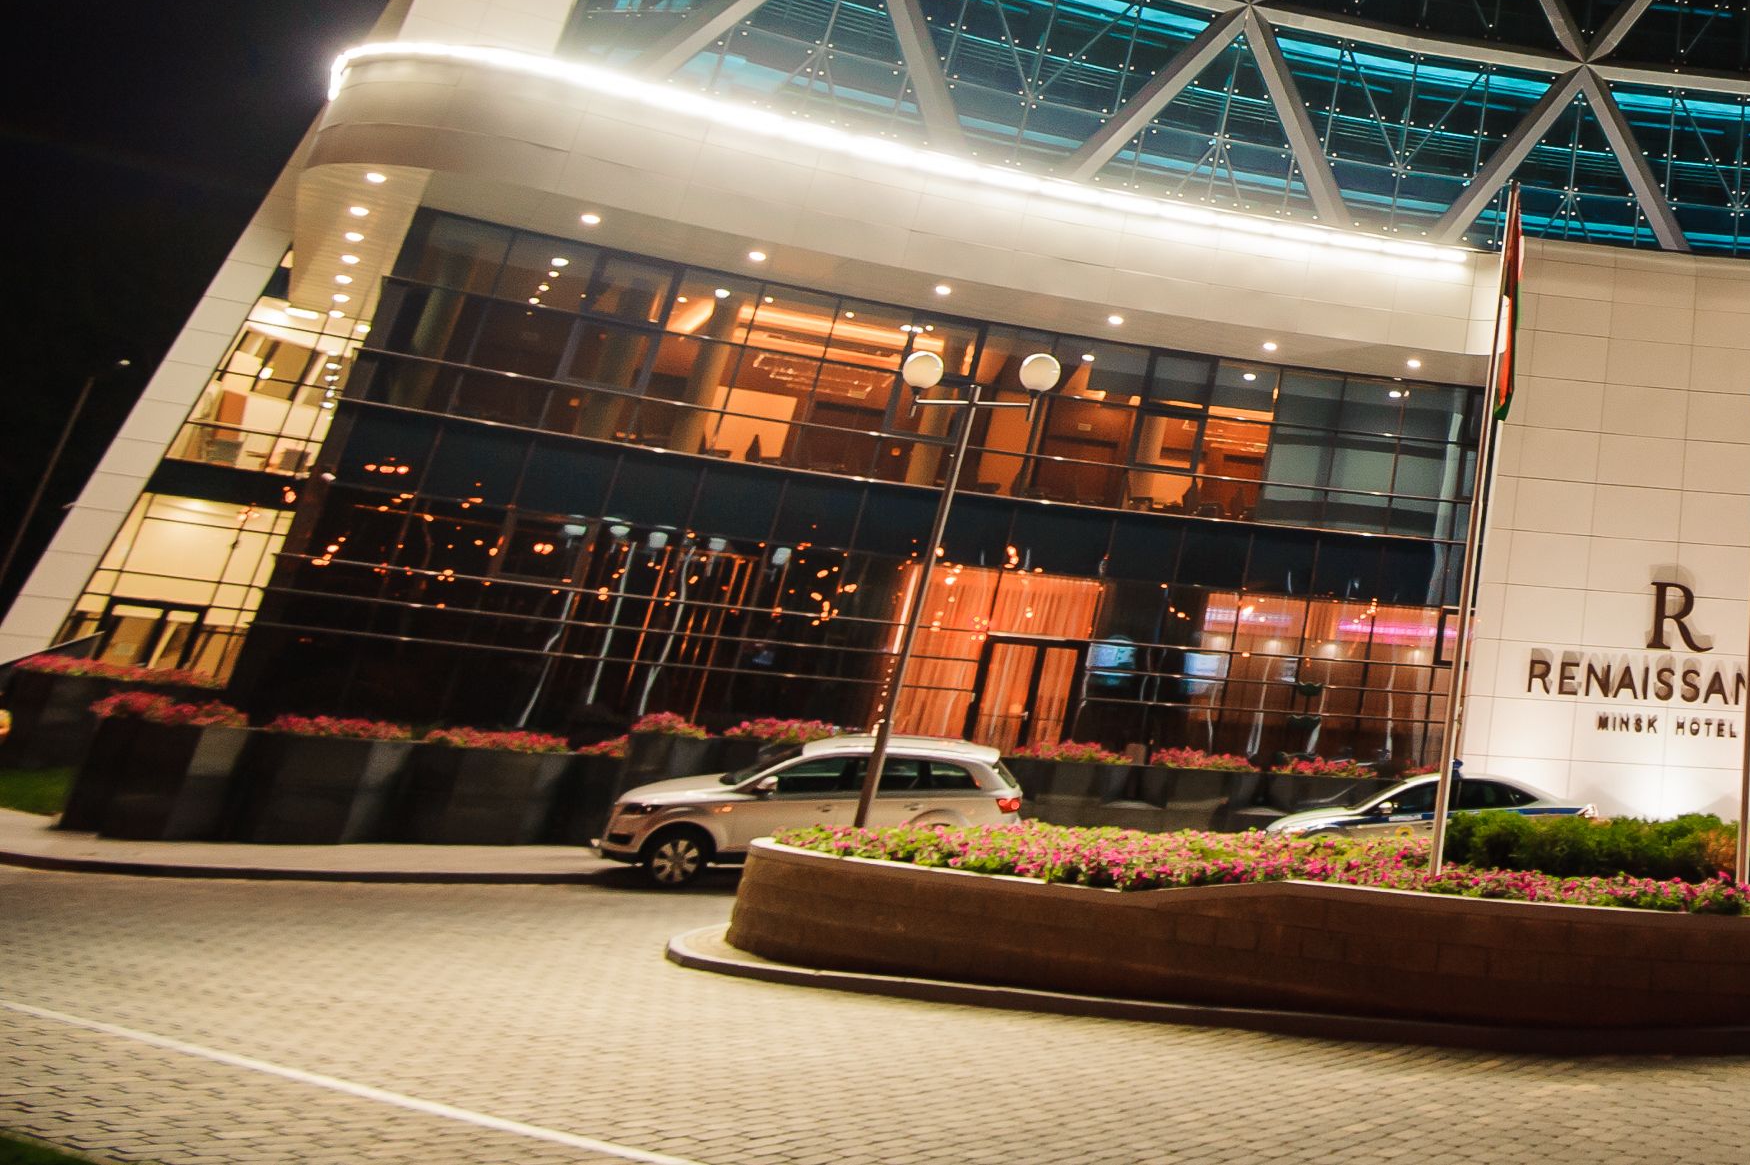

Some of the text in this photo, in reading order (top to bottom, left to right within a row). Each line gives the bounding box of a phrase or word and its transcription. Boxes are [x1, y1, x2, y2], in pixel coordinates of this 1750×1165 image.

[1646, 581, 1714, 652] R
[1597, 714, 1737, 738] MINSK HOTEL
